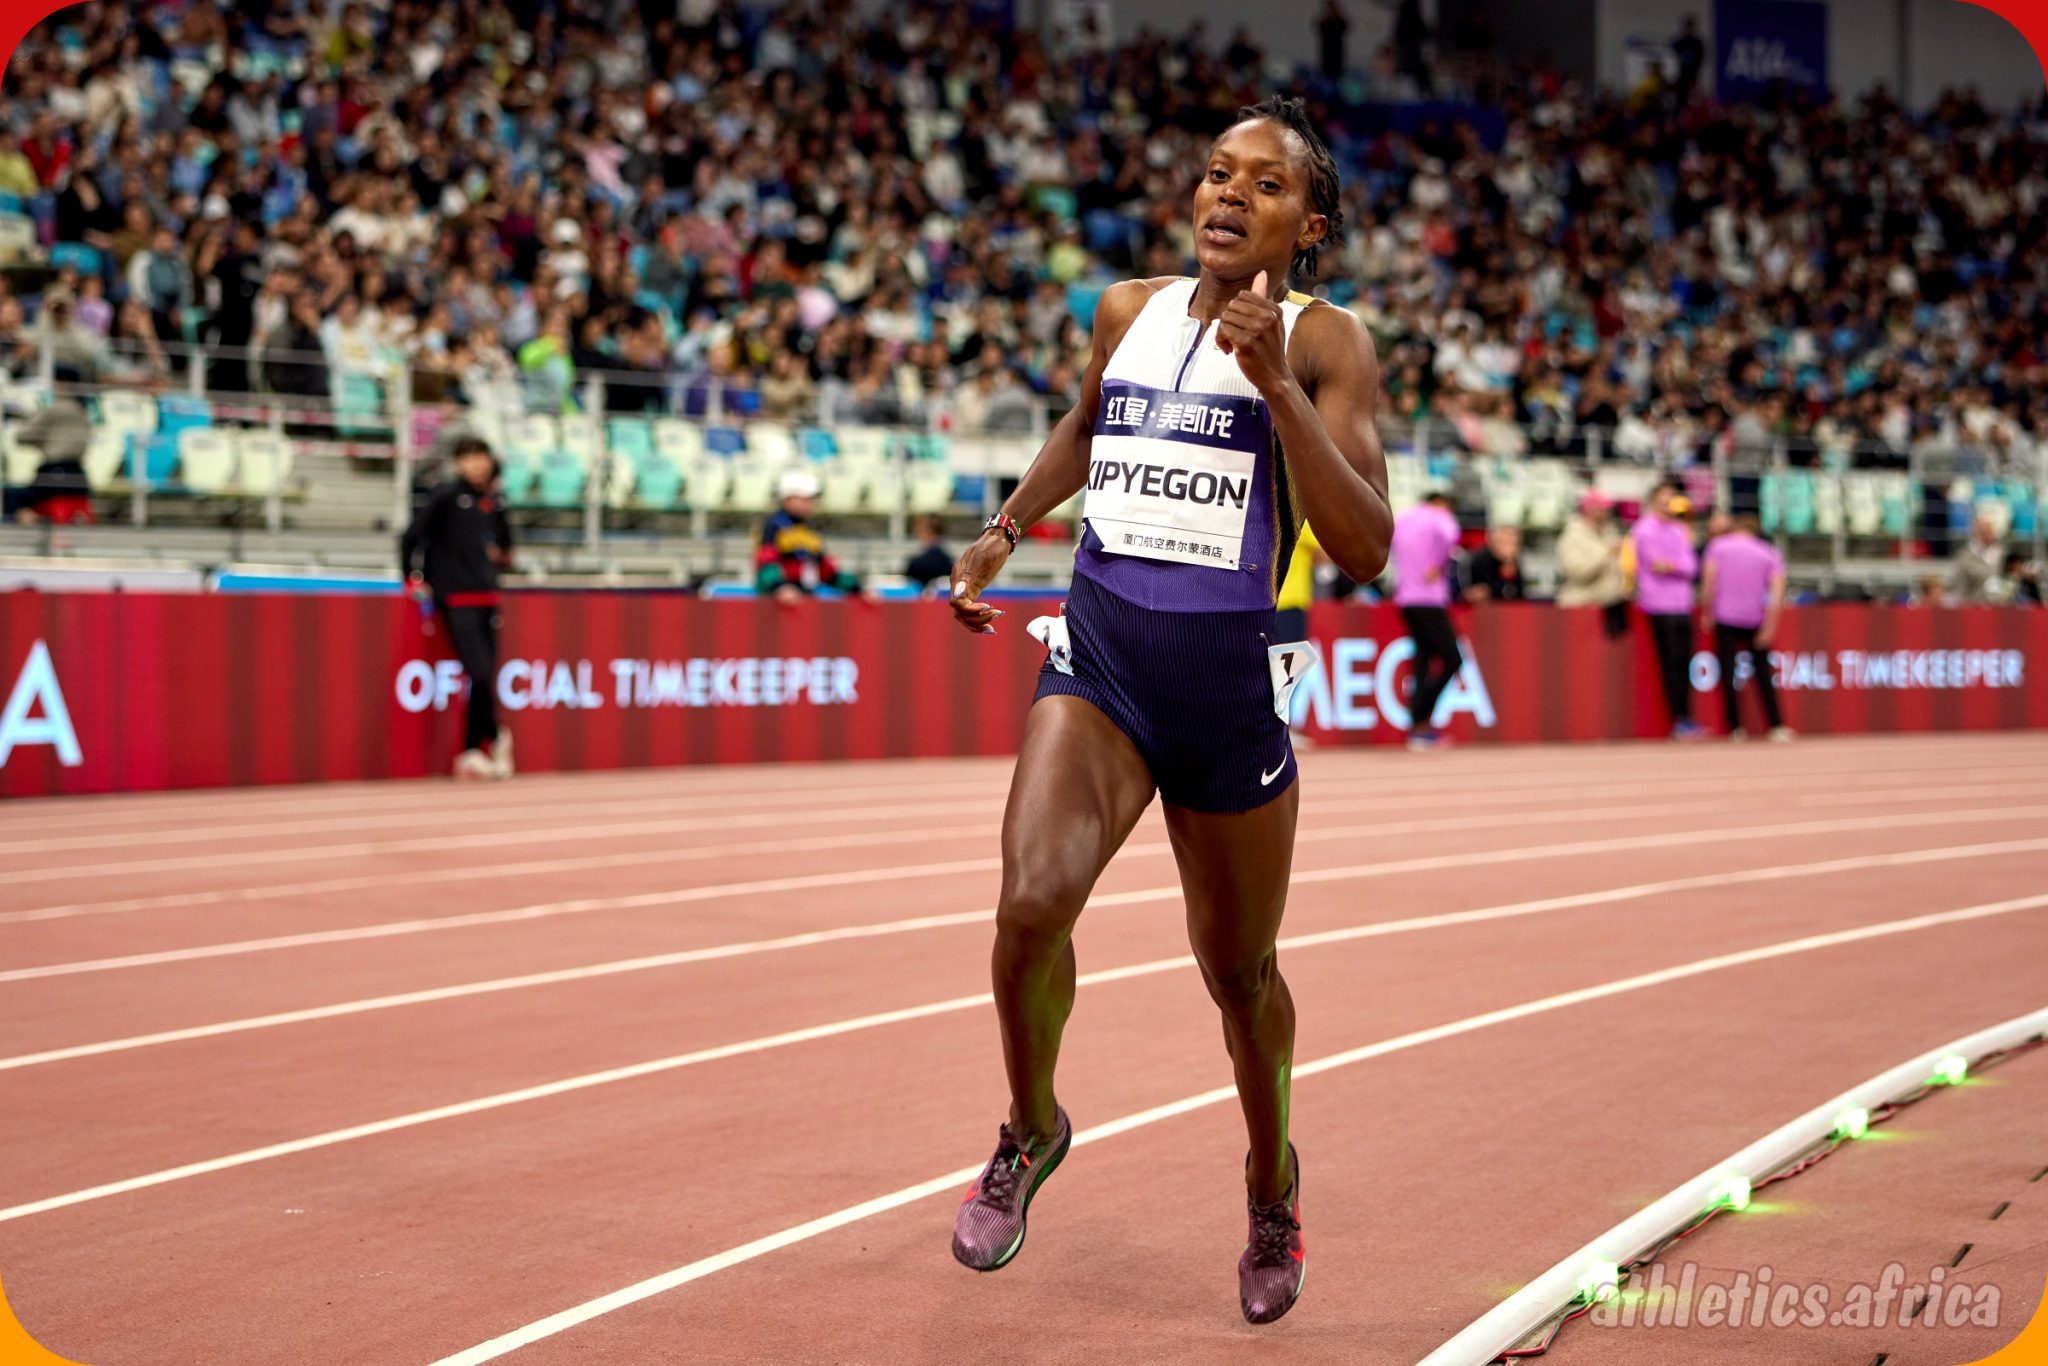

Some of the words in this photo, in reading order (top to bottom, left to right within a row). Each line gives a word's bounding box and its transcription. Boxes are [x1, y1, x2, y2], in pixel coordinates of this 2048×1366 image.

[1105, 396, 1235, 439] 红星·美凯龙
[1123, 533, 1224, 559] 厦门航空费尔蒙酒店
[395, 658, 604, 712] OFCIAL
[610, 656, 860, 708] TIMEKEEPER
[1836, 649, 2026, 691] TIMEKEEPER
[0, 637, 84, 768] A
